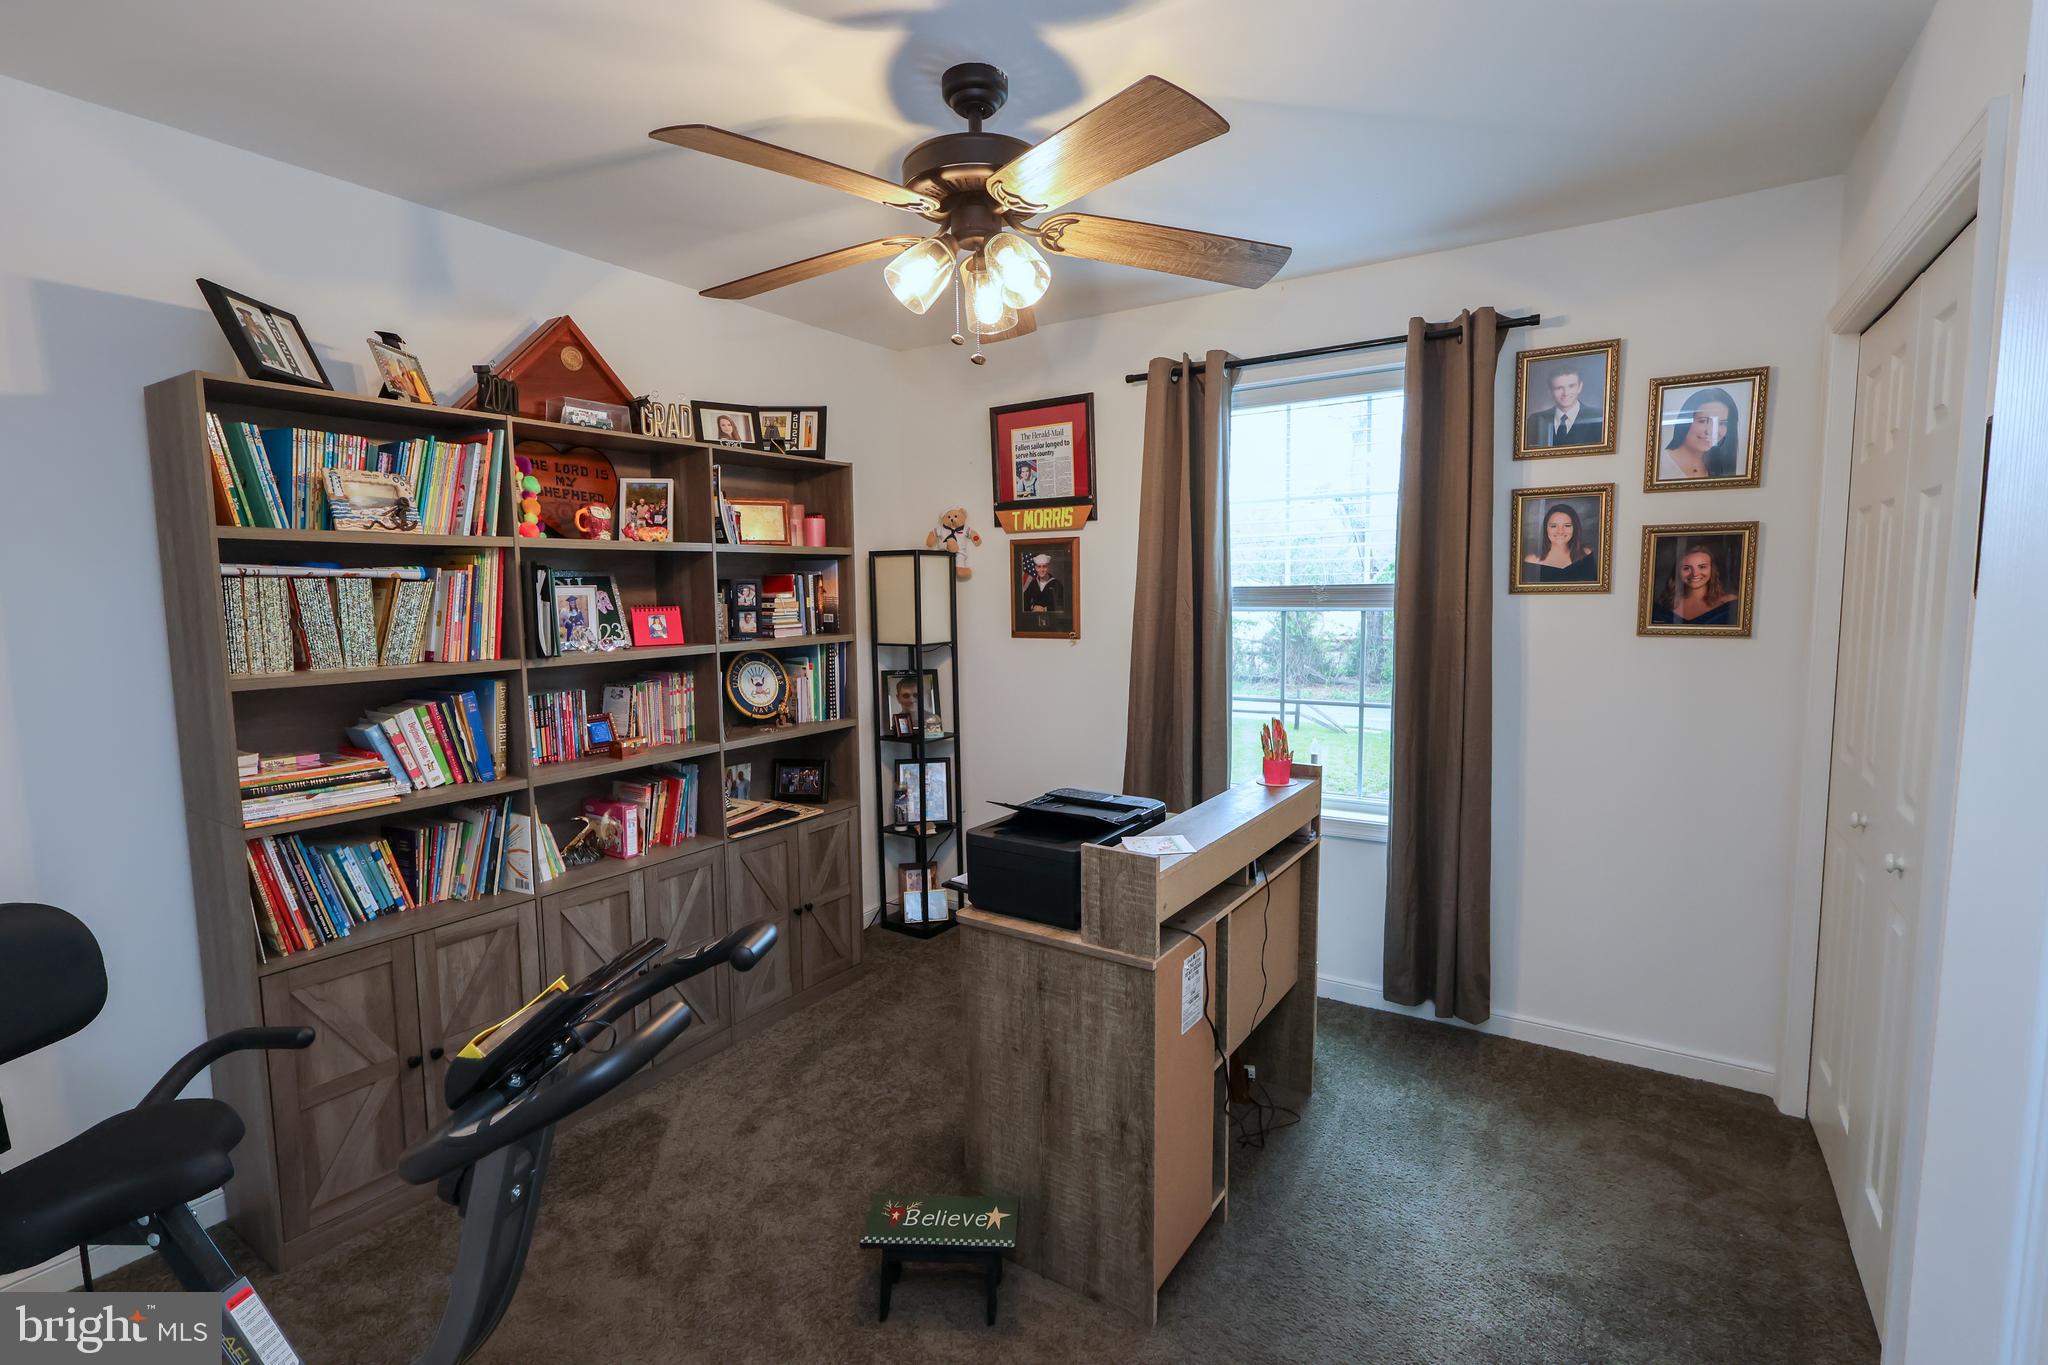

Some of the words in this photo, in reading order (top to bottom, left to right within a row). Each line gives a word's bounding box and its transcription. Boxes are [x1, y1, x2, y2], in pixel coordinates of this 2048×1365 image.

[641, 402, 693, 438] GRAD
[1021, 432, 1031, 441] The
[1032, 429, 1064, 439] Herald-Mail
[1015, 443, 1030, 451] Fallen
[1031, 442, 1044, 450] sailor
[1045, 440, 1063, 449] longed
[531, 459, 548, 471] HE
[555, 463, 588, 477] LORD
[596, 468, 609, 480] IS
[556, 476, 576, 488] MY
[1012, 511, 1020, 531] T
[1023, 506, 1073, 530] MORRIS
[752, 703, 775, 713] NAVY
[498, 724, 507, 752] BIBLE
[250, 786, 271, 796] THE
[902, 1208, 988, 1227] Believe
